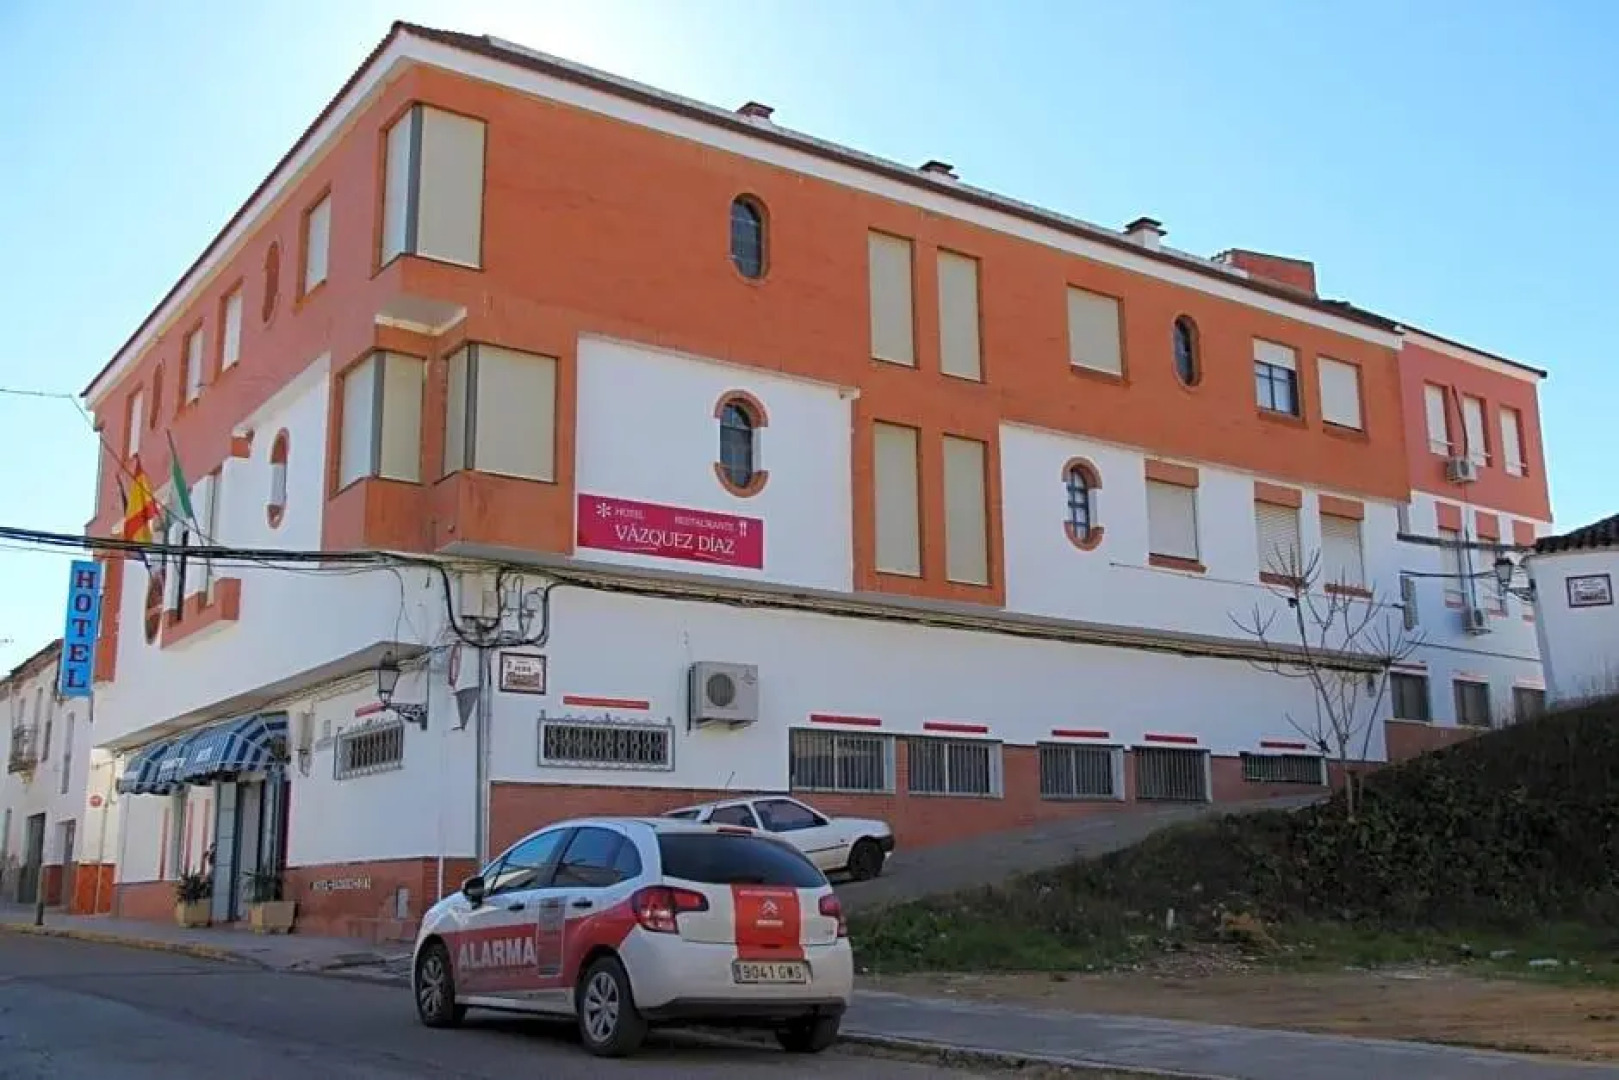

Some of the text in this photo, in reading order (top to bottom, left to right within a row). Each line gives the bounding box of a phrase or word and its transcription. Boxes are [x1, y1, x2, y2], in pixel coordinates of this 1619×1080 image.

[614, 523, 735, 555] VÁZQUEZ DÍAZ
[67, 570, 97, 688] HOTEL
[458, 936, 538, 969] ALARMA
[743, 964, 775, 979] 9041
